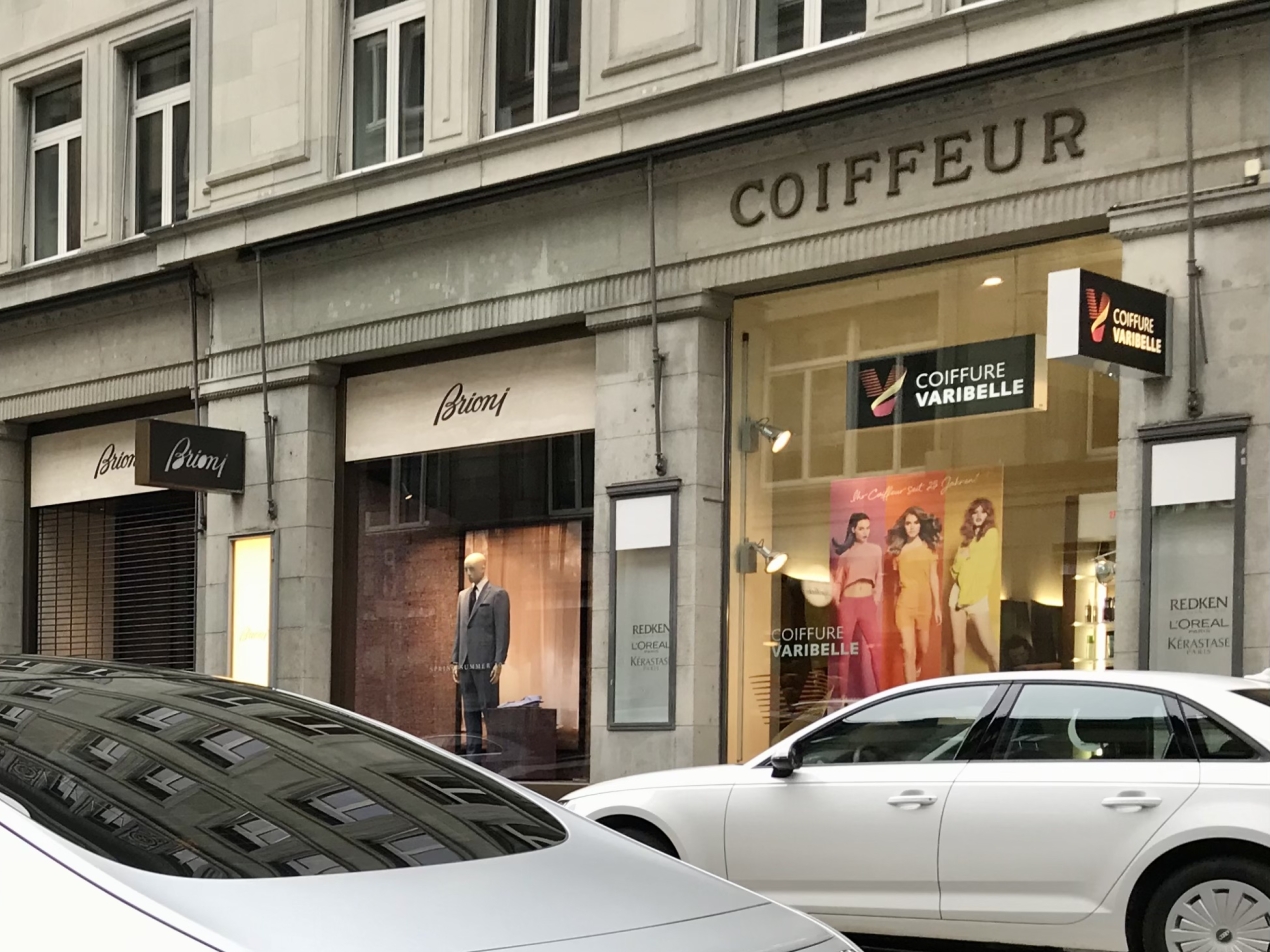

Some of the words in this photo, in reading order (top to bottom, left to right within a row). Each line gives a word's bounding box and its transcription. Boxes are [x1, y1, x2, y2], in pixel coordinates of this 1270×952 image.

[730, 106, 1088, 228] COIFFEUR
[1112, 308, 1154, 334] COIFFURE
[1112, 326, 1162, 354] VARIBELLE
[915, 362, 1006, 390] COIFFURE
[433, 382, 512, 426] Brioni
[915, 378, 1025, 408] VARIBELLE
[94, 443, 136, 480] Brion
[164, 436, 230, 479] Brioni
[1170, 596, 1228, 611] REDKEN
[632, 623, 670, 635] REDKEN
[772, 626, 844, 642] COIFFURE
[772, 642, 859, 658] VARIBELLE
